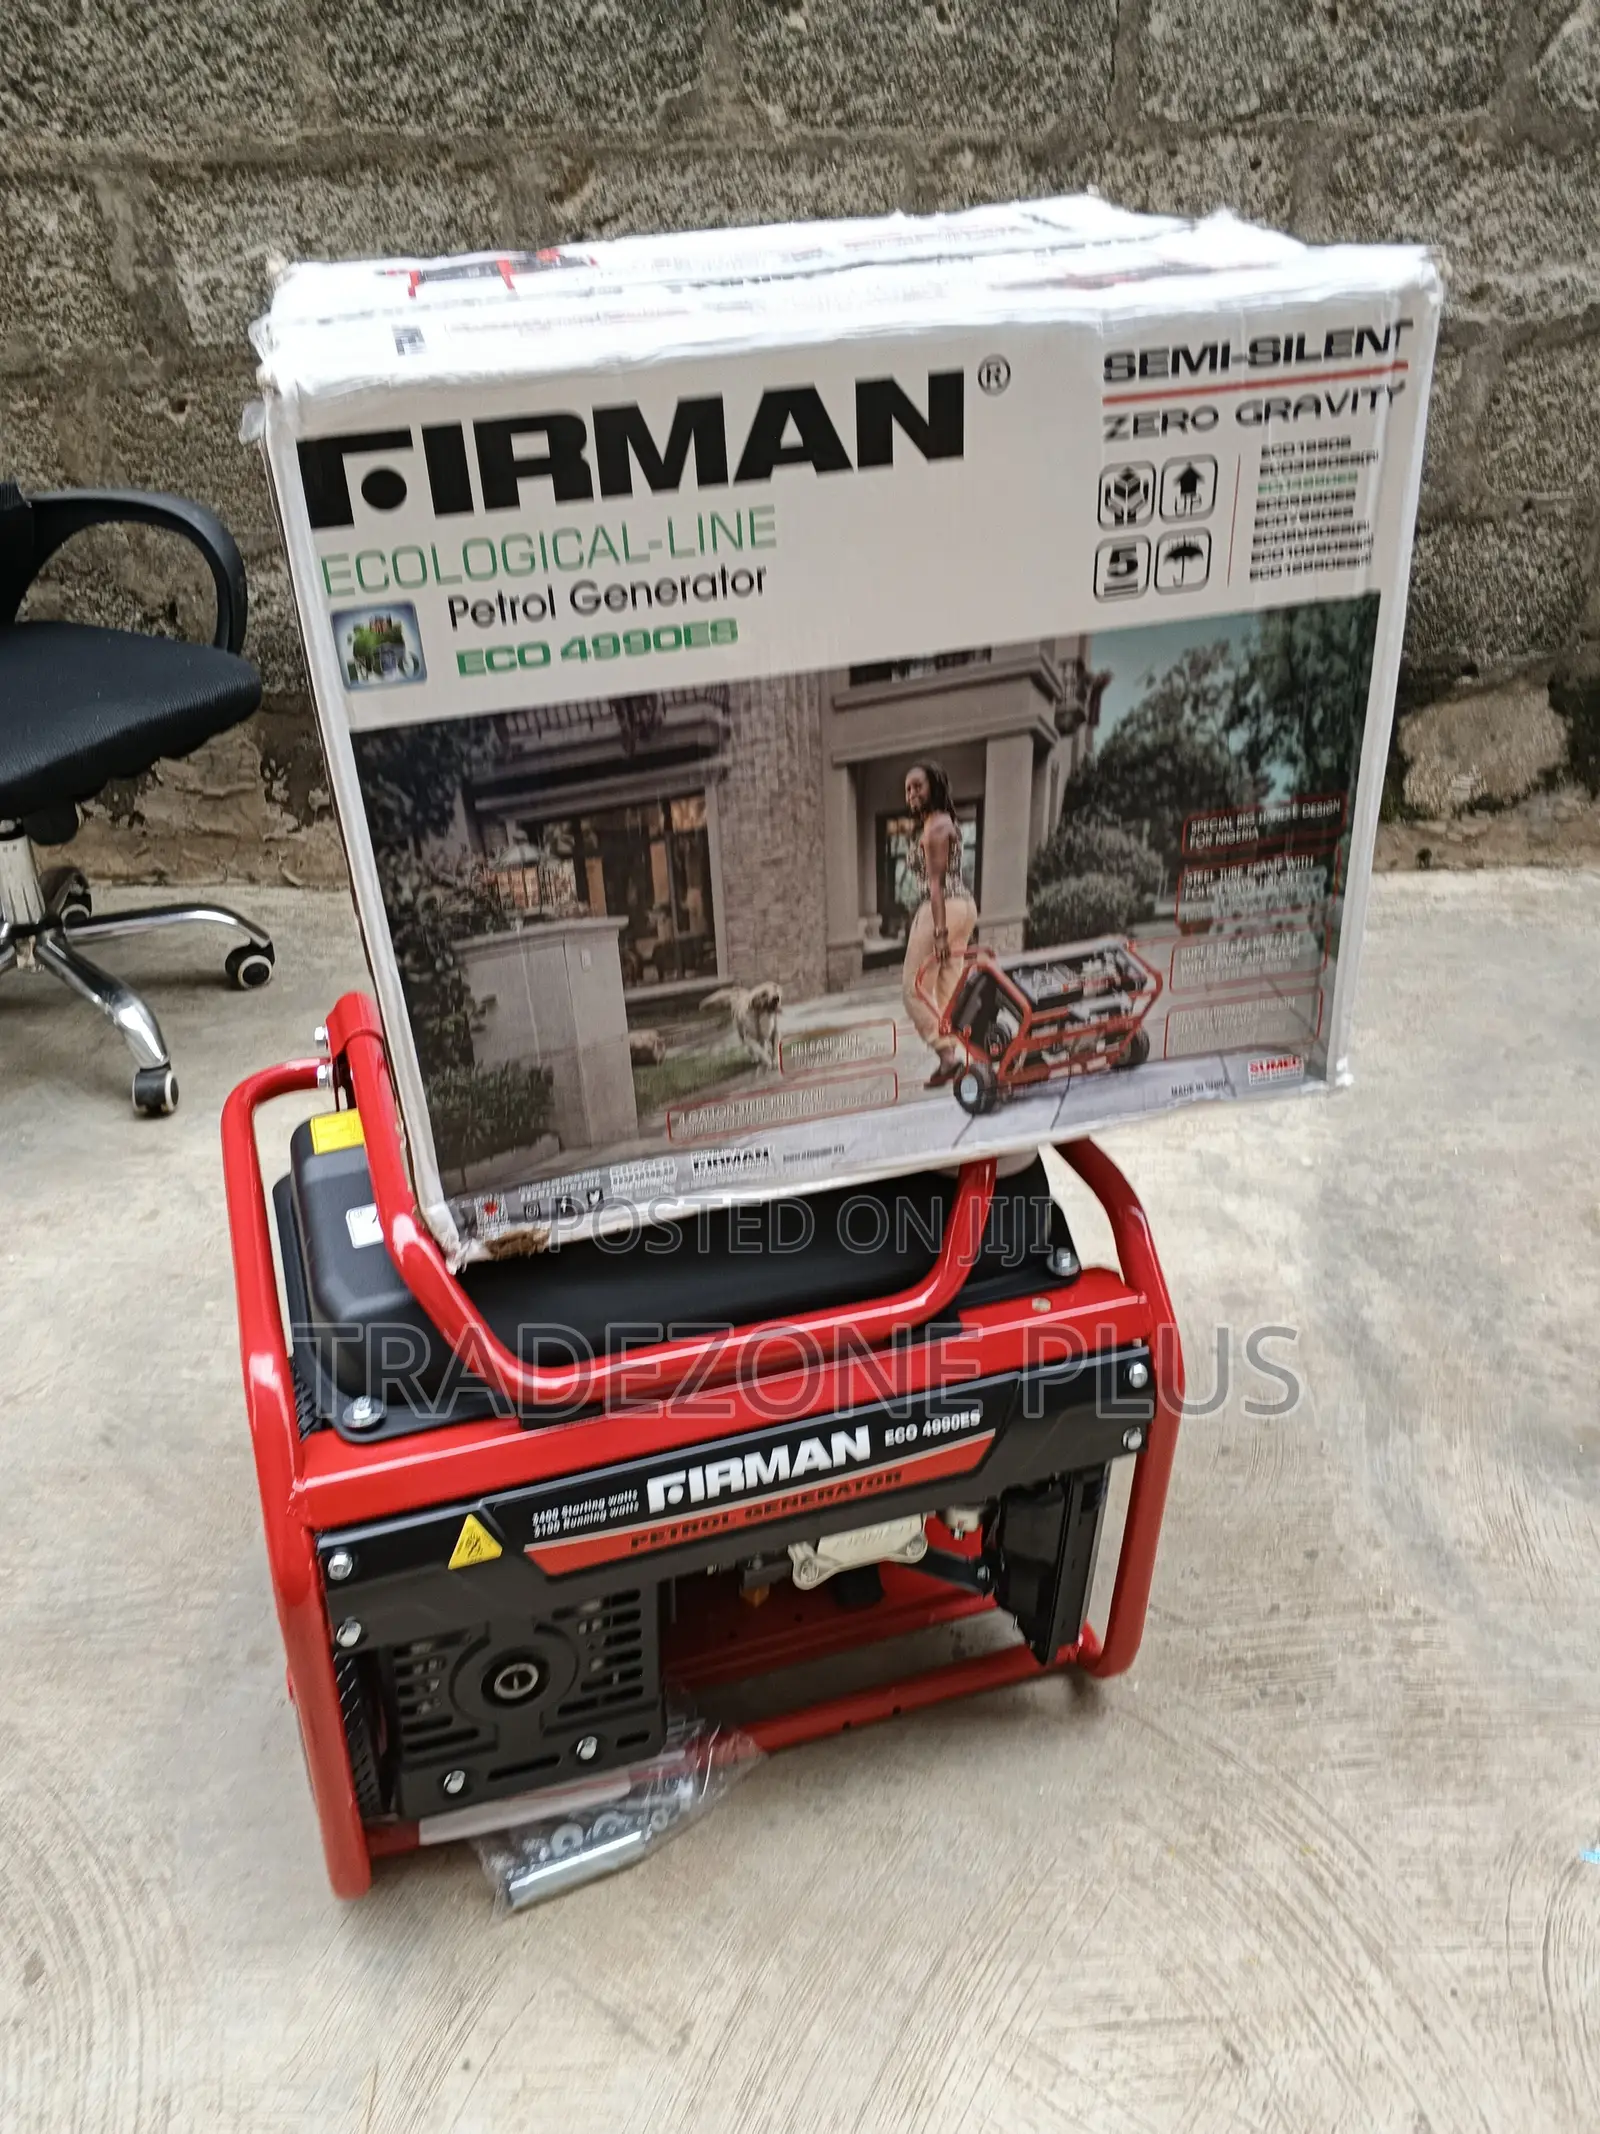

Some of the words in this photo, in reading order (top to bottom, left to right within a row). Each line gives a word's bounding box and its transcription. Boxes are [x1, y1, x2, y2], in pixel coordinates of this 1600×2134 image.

[1103, 319, 1413, 384] SEMI-SILENT
[1103, 405, 1219, 442] ZERO
[1235, 382, 1405, 427] GRAVITY
[297, 368, 964, 529] FIRMAN
[321, 504, 777, 597] ECOLOGICAL-LINE
[448, 585, 557, 631] Petrol
[569, 565, 767, 616] Generator
[456, 641, 552, 677] ECO
[560, 618, 739, 665] 4990ES
[885, 1423, 918, 1447] ECO
[922, 1408, 982, 1439] 4990ES
[646, 1425, 871, 1514] FIRMAN
[561, 1497, 606, 1521] Starting
[608, 1489, 639, 1507] watts
[563, 1509, 608, 1531] Running
[610, 1501, 640, 1519] watts
